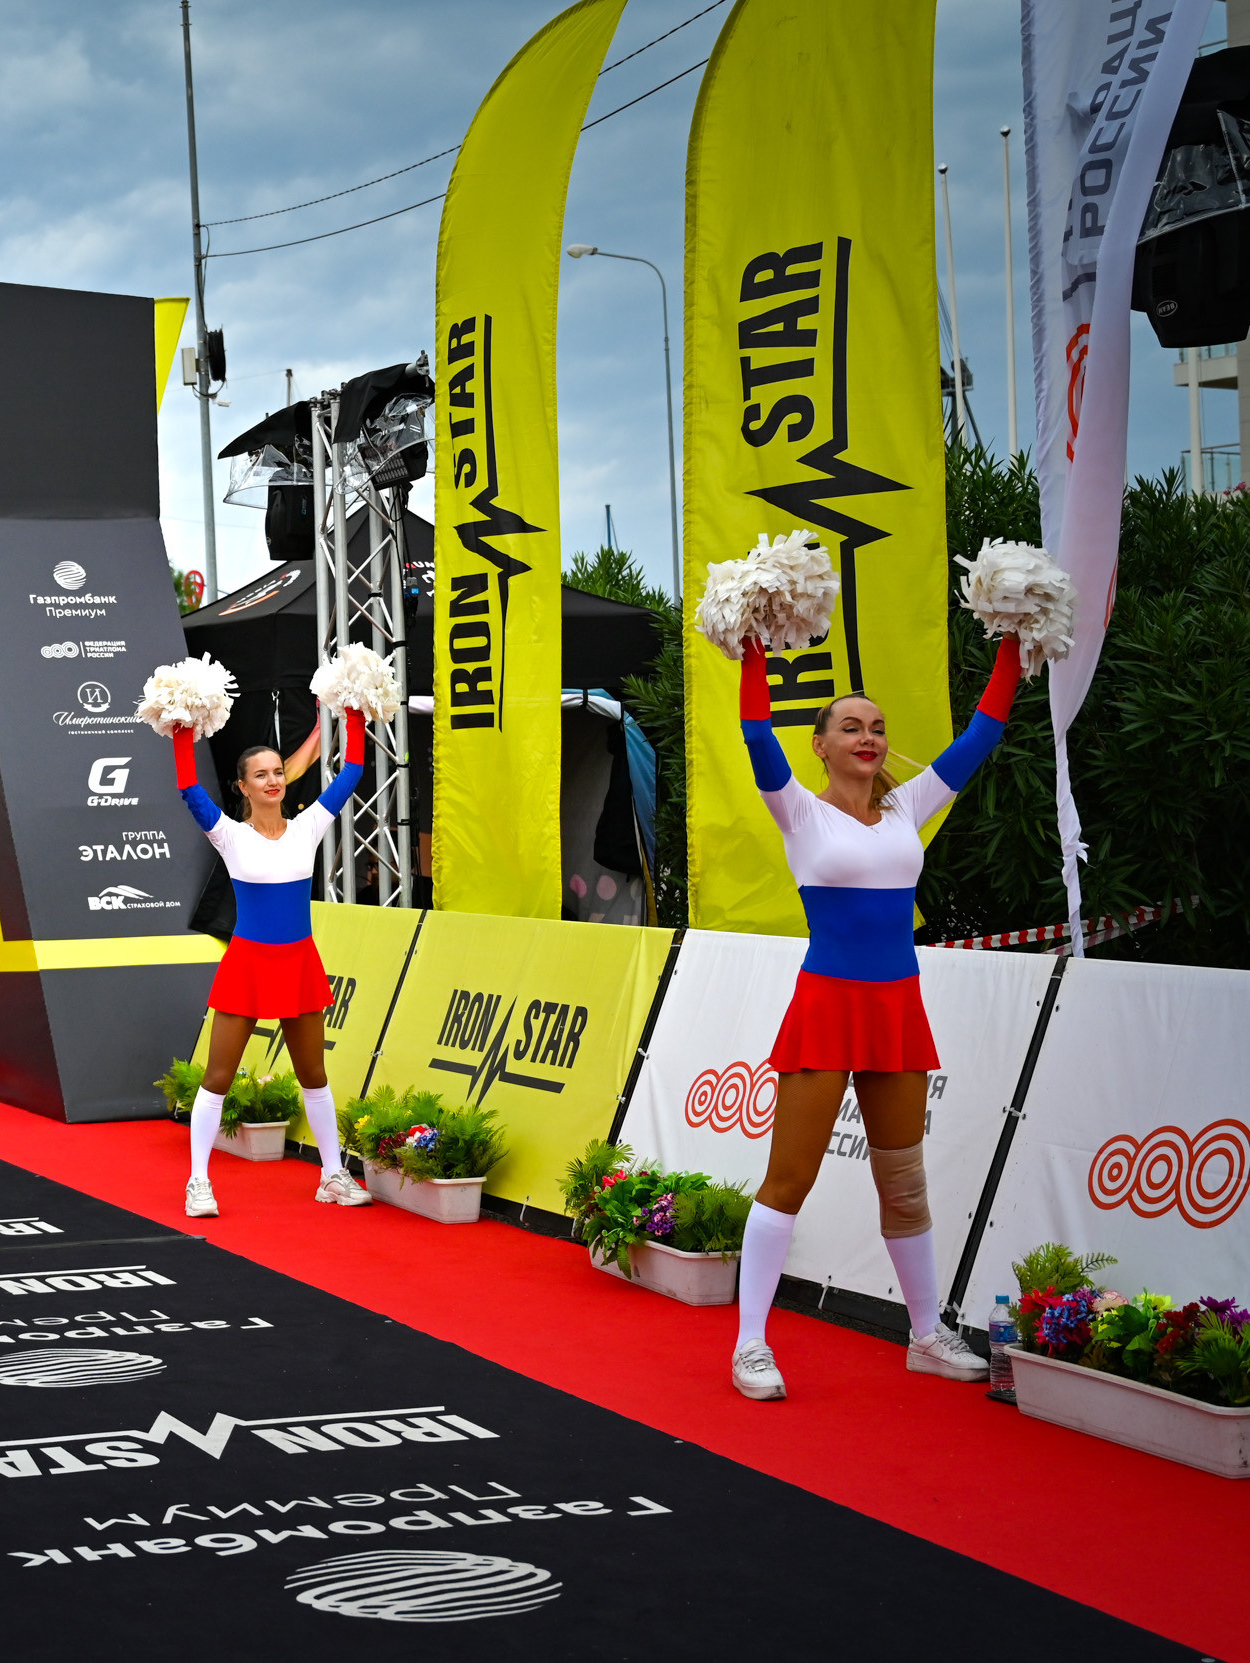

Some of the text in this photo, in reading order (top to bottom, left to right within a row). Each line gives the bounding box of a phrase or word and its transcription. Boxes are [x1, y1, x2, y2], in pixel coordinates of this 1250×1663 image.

[738, 240, 824, 449] STAR
[448, 314, 477, 490] STAR
[29, 593, 118, 606] Газпромбанк
[46, 606, 107, 618] Премиум
[449, 571, 495, 730] IRON
[78, 843, 171, 862] ЭТАЛОН
[122, 831, 166, 841] ГРУППА
[88, 896, 127, 911] ВСК
[127, 901, 165, 909] СТРАХОВОЙ
[437, 988, 588, 1069] IRON STAR
[250, 1414, 501, 1455] IRON
[83, 1481, 522, 1531] Премиум
[7, 1496, 673, 1567] Газпромбанк
